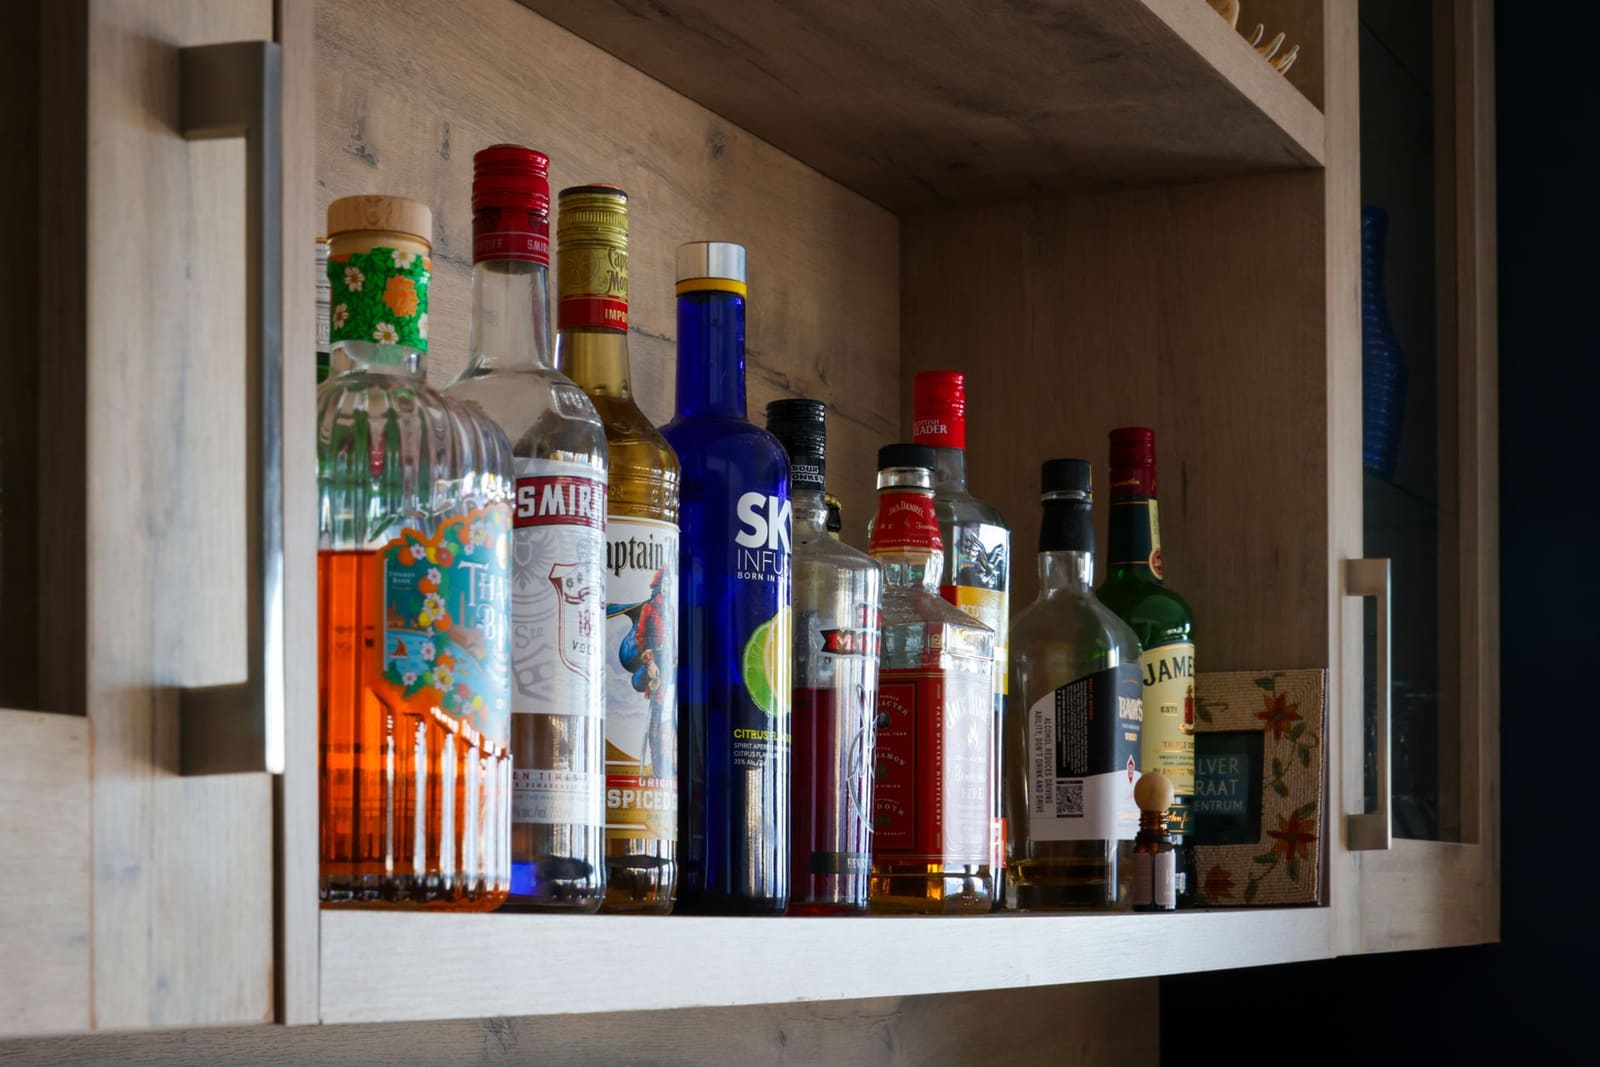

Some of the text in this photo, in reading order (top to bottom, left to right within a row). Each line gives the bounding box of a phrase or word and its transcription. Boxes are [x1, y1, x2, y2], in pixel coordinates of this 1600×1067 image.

[605, 308, 628, 323] IMPO
[517, 483, 596, 519] SMIR
[735, 491, 792, 554] SK
[737, 548, 785, 575] INFU
[737, 571, 776, 583] BORN IN
[1142, 655, 1193, 687] JAME
[1043, 717, 1054, 804] ALCOHOL REDUCES DRIVING
[1199, 757, 1240, 775] LVER
[1196, 778, 1240, 797] RAAT
[607, 789, 674, 811] SPICED
[1193, 798, 1244, 812] ENTRUM
